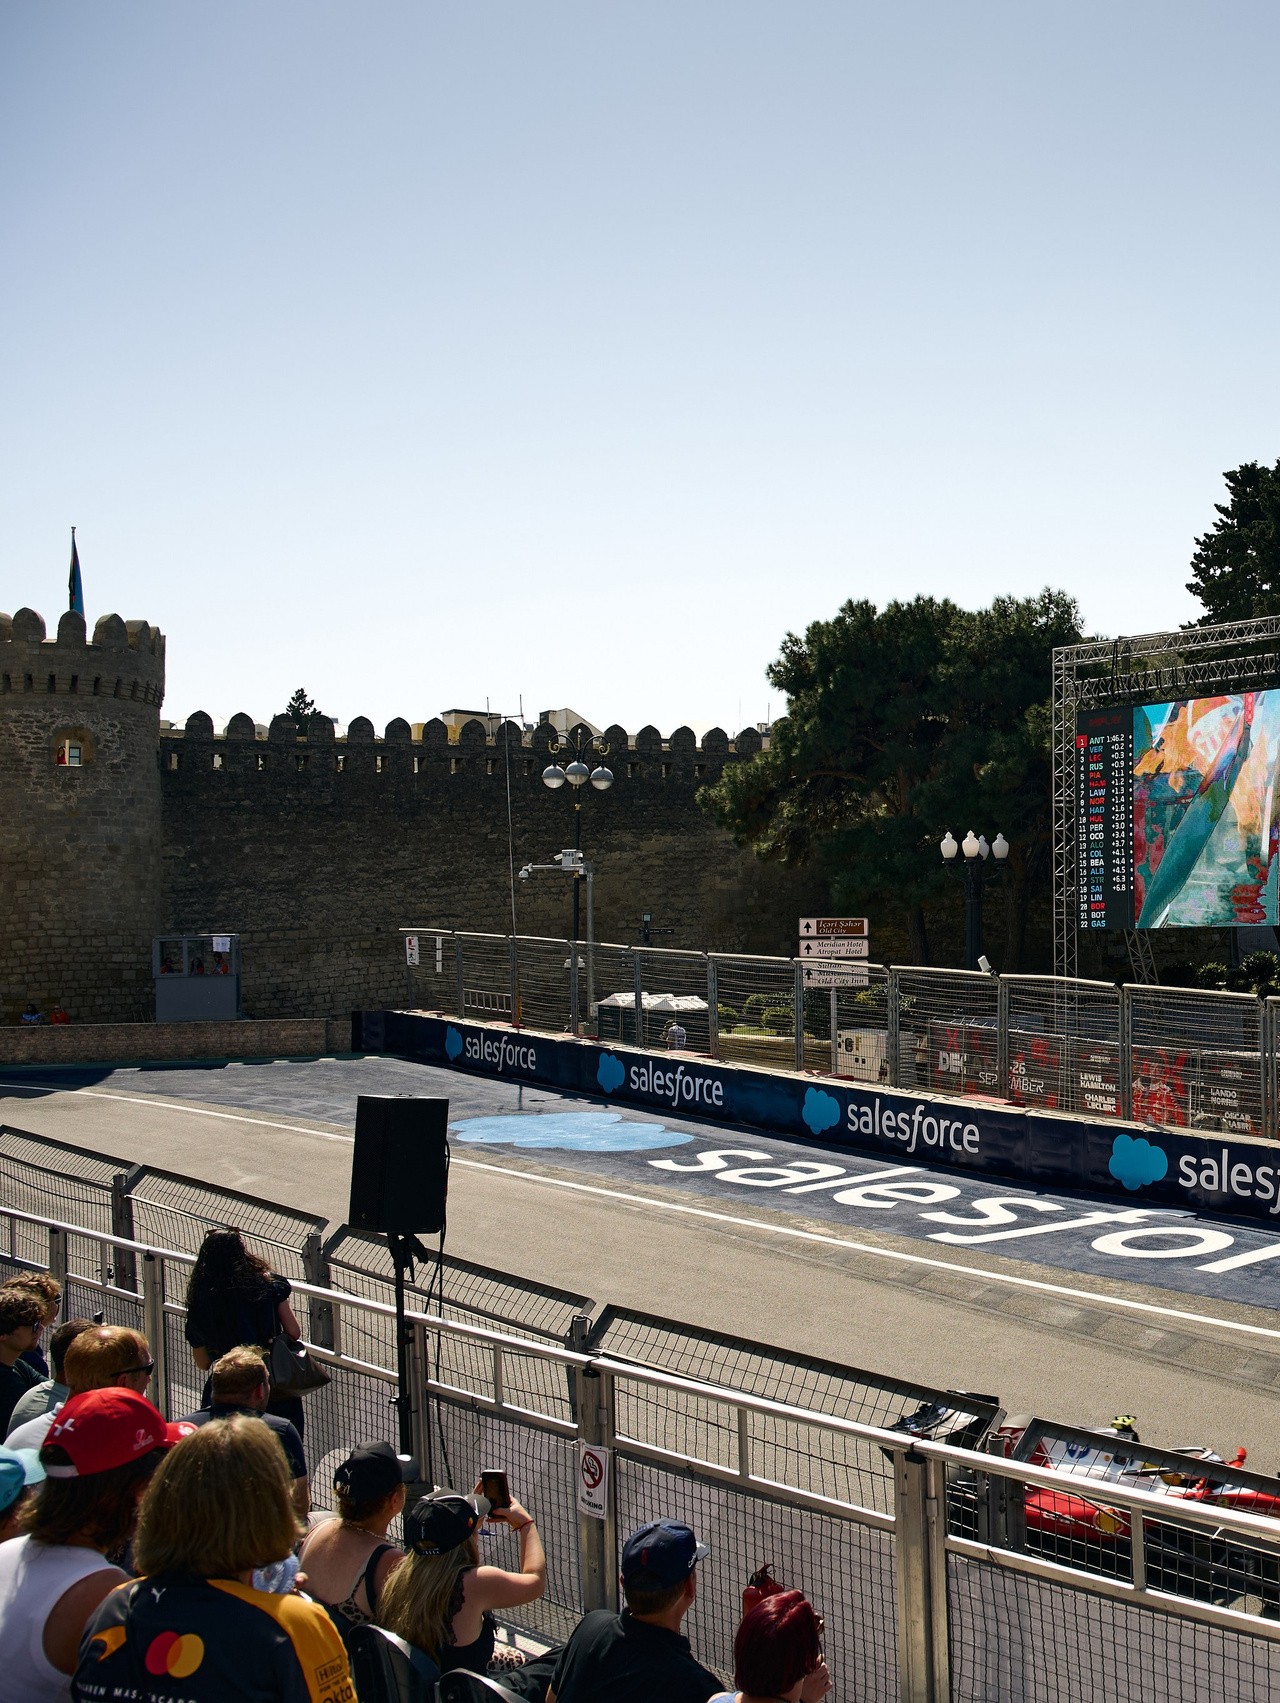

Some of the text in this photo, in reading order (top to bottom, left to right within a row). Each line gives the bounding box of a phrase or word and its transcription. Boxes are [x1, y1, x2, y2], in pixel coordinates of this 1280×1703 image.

[1089, 754, 1102, 762] LEC
[1111, 760, 1124, 768] +0.9
[1089, 780, 1106, 788] HAM
[1111, 778, 1124, 786] +1.2
[1090, 789, 1106, 797] LAW
[1089, 797, 1105, 805] NOR
[1090, 806, 1105, 814] HAD
[1111, 804, 1125, 812] +1.6
[1112, 822, 1125, 830] +3.0
[1090, 832, 1104, 840] OCO
[1112, 866, 1126, 874] +4.5
[1090, 876, 1104, 884] STR
[1090, 902, 1105, 910] BOR
[817, 948, 841, 957] Atropat
[465, 1032, 537, 1072] salesforce
[1080, 1072, 1102, 1082] LEWIS
[629, 1061, 724, 1107] salesforce
[1080, 1080, 1116, 1092] HAMILTON
[1210, 1088, 1237, 1099] LANDO
[847, 1098, 980, 1154] salesforce
[586, 1490, 593, 1498] NO
